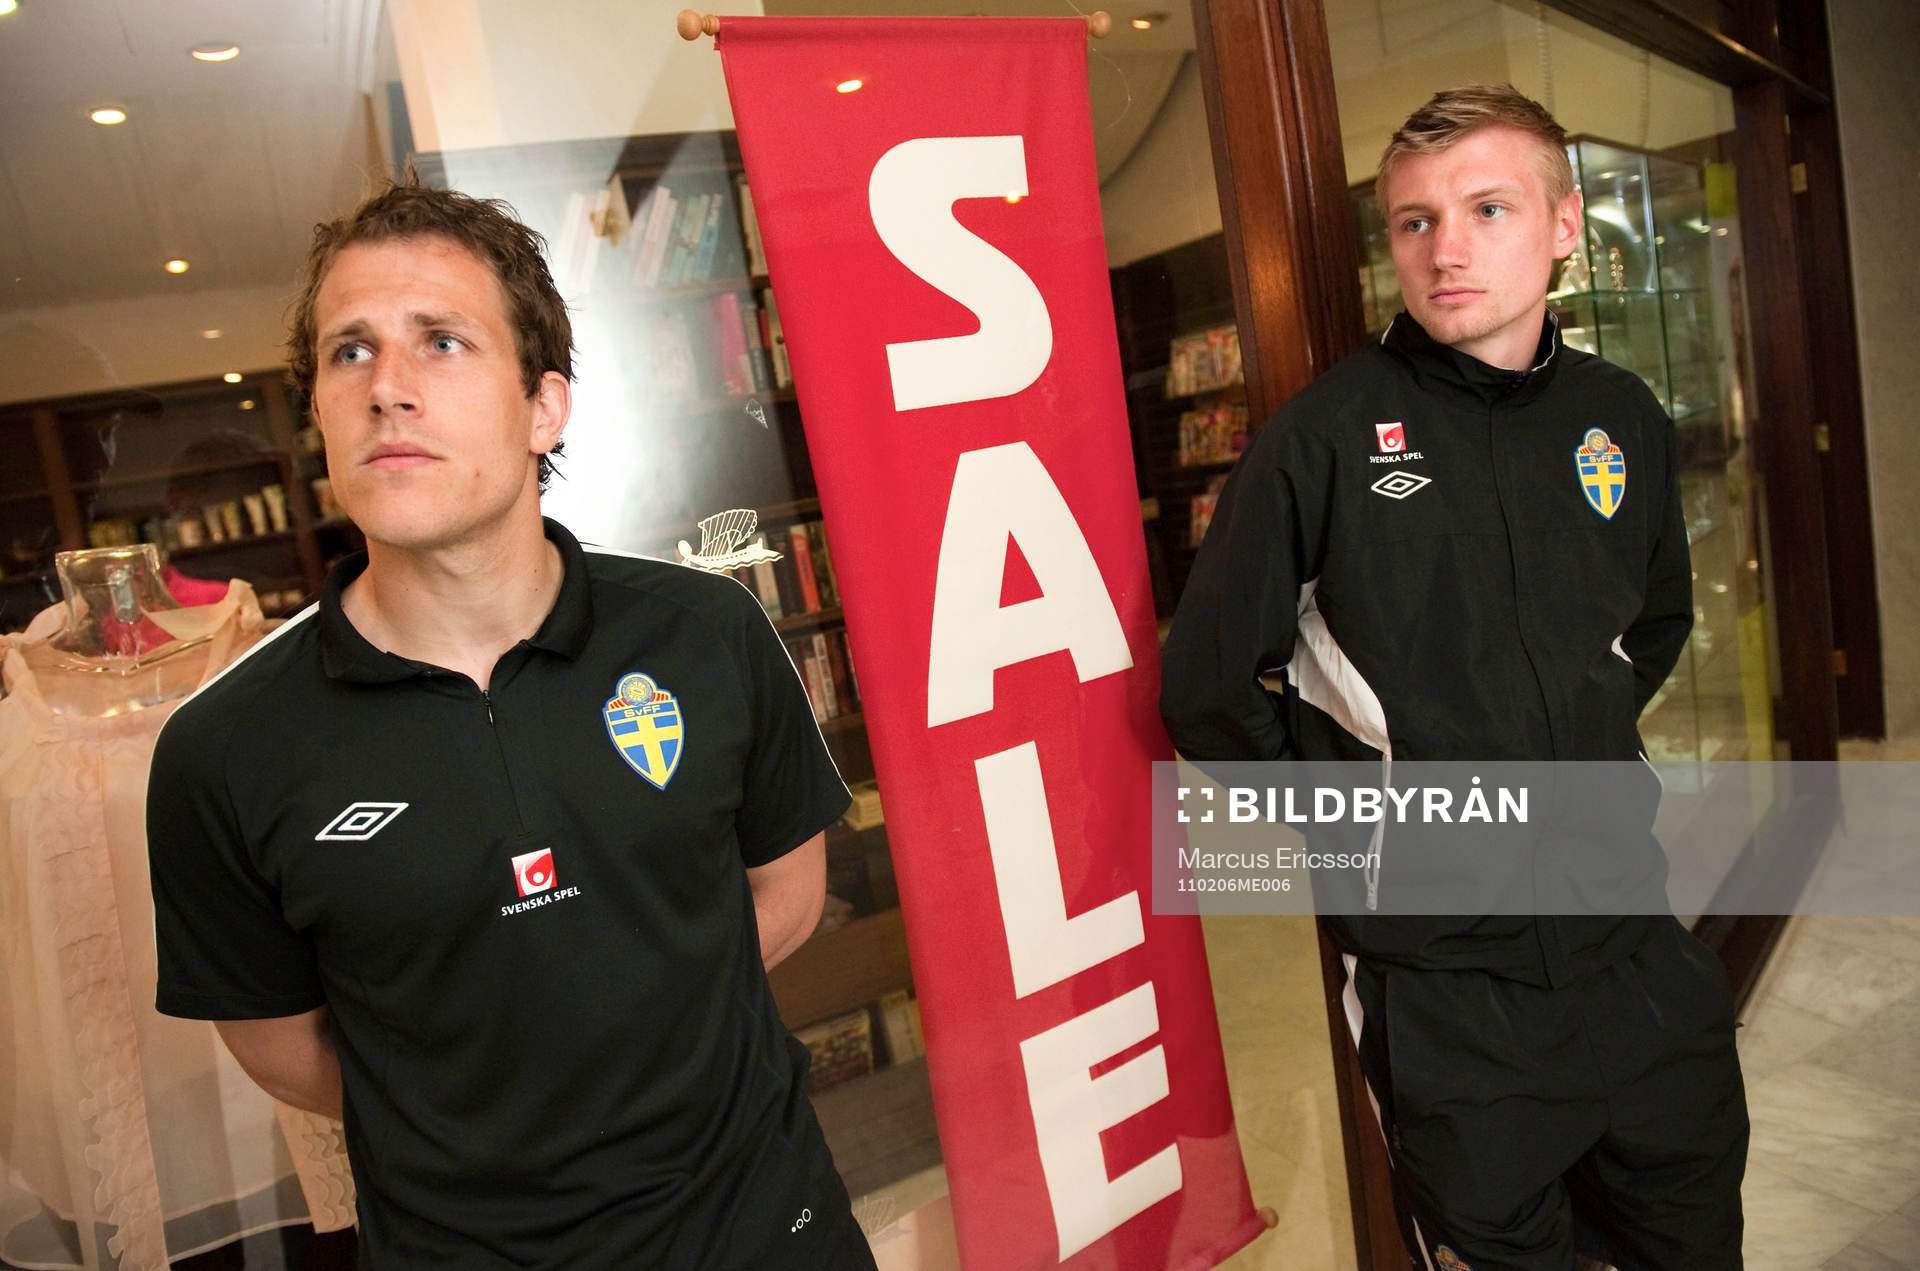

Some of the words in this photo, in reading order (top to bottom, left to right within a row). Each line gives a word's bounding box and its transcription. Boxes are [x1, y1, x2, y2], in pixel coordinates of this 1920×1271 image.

[1369, 454, 1401, 464] SVENSKA
[1402, 451, 1424, 461] SPEL
[868, 135, 1182, 1263] SALE
[623, 704, 661, 718] SvFF
[501, 894, 553, 916] SVENSKA
[553, 886, 581, 901] SPEL
